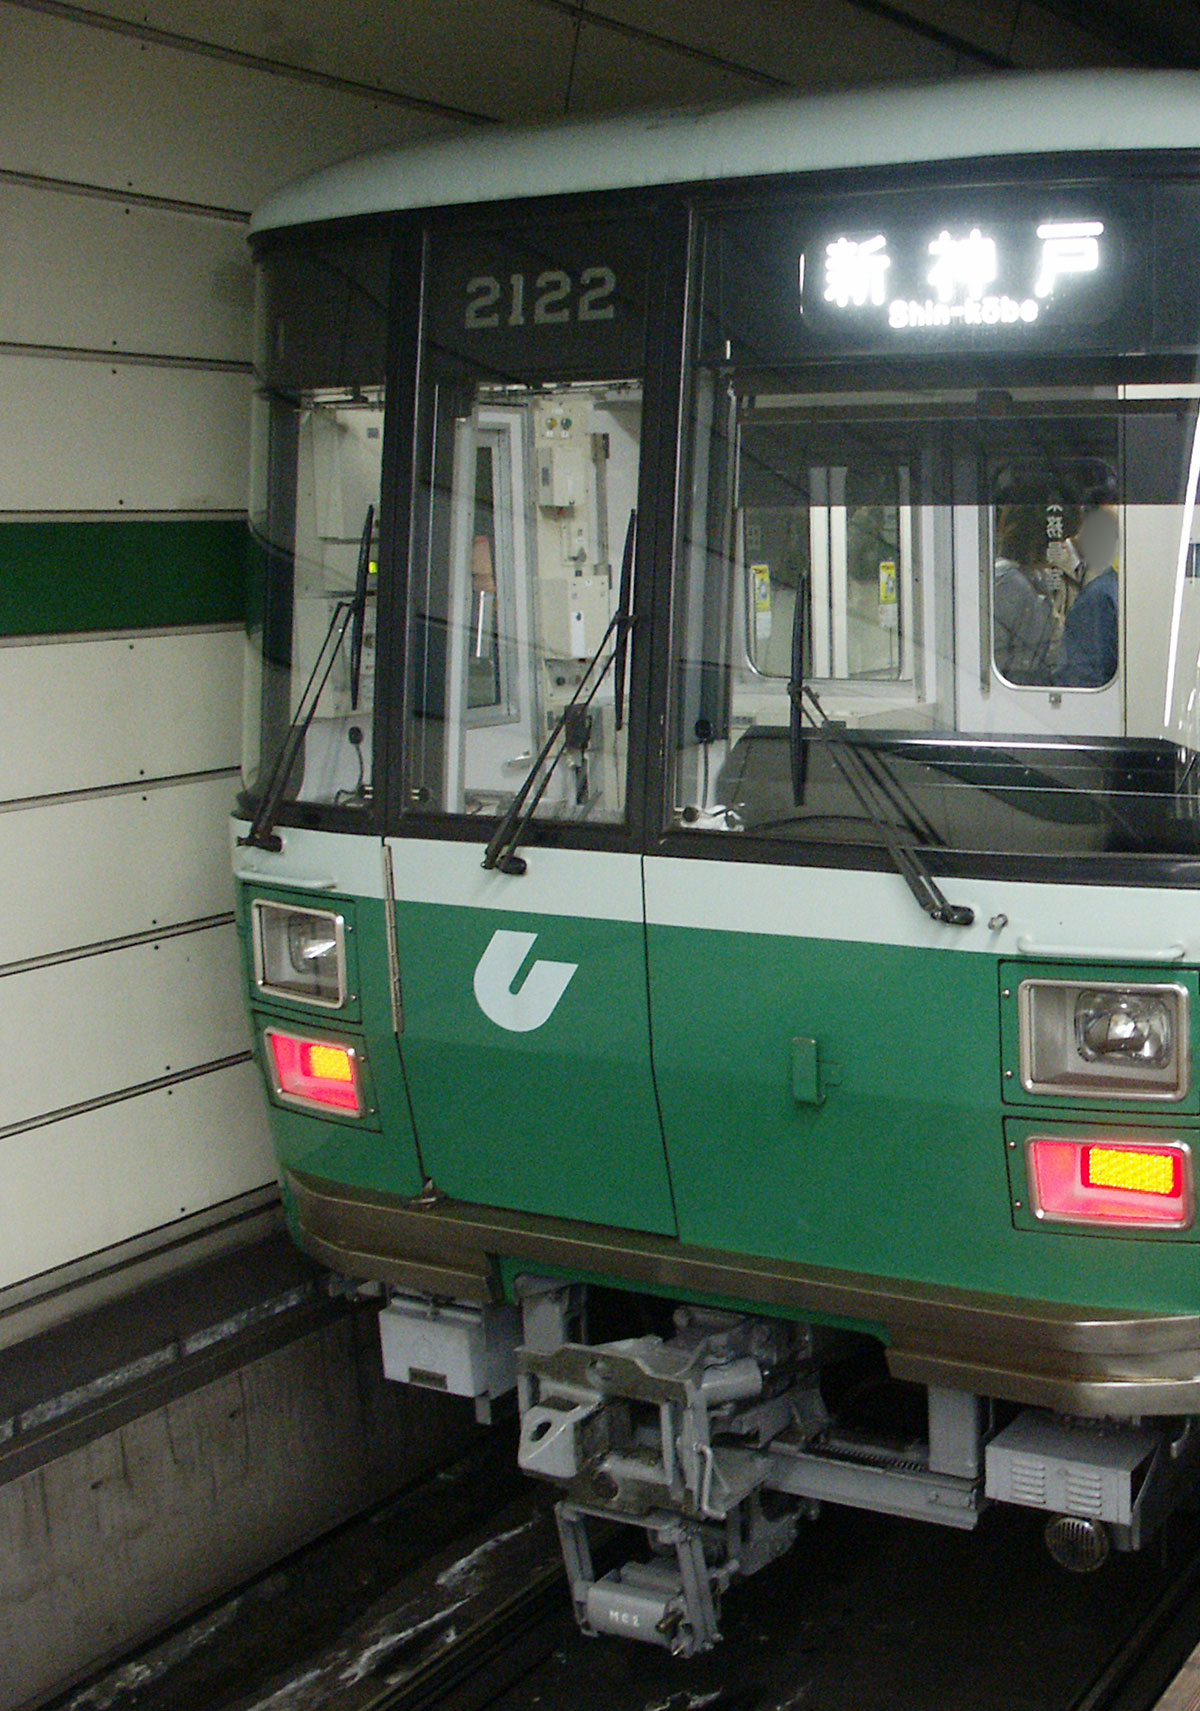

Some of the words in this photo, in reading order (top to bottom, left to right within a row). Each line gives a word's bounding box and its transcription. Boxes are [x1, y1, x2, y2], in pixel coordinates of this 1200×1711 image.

[465, 266, 616, 329] 2122
[825, 221, 1104, 307] 新神戸
